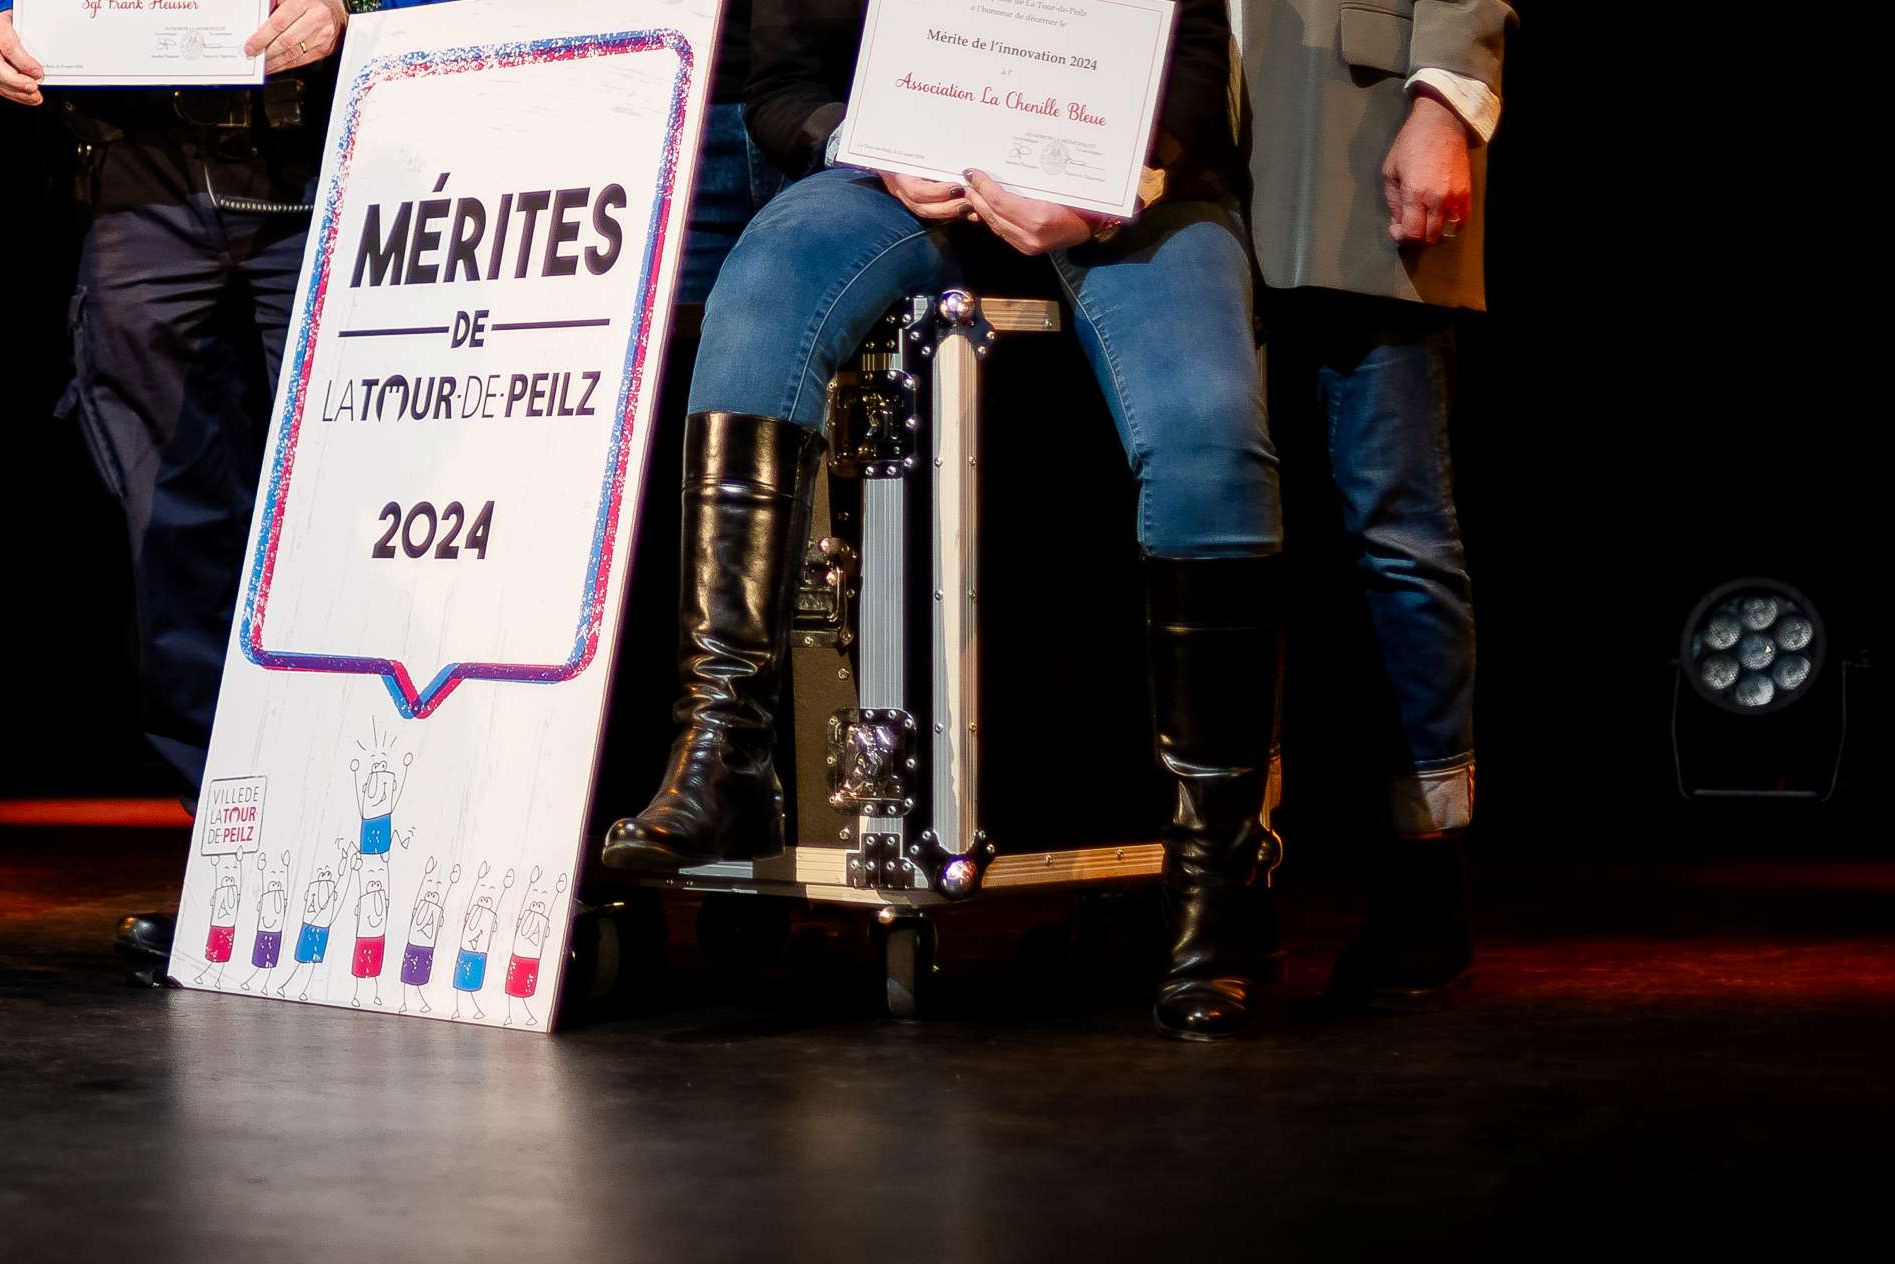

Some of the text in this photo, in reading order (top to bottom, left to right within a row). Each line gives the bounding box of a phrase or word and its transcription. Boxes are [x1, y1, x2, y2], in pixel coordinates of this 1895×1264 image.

[927, 28, 1098, 71] Mérite de l'innovation 2024
[895, 71, 1106, 127] Association La Chenille Bleue
[349, 172, 627, 289] MÉRITES
[451, 310, 490, 349] DE
[371, 500, 496, 561] 2024
